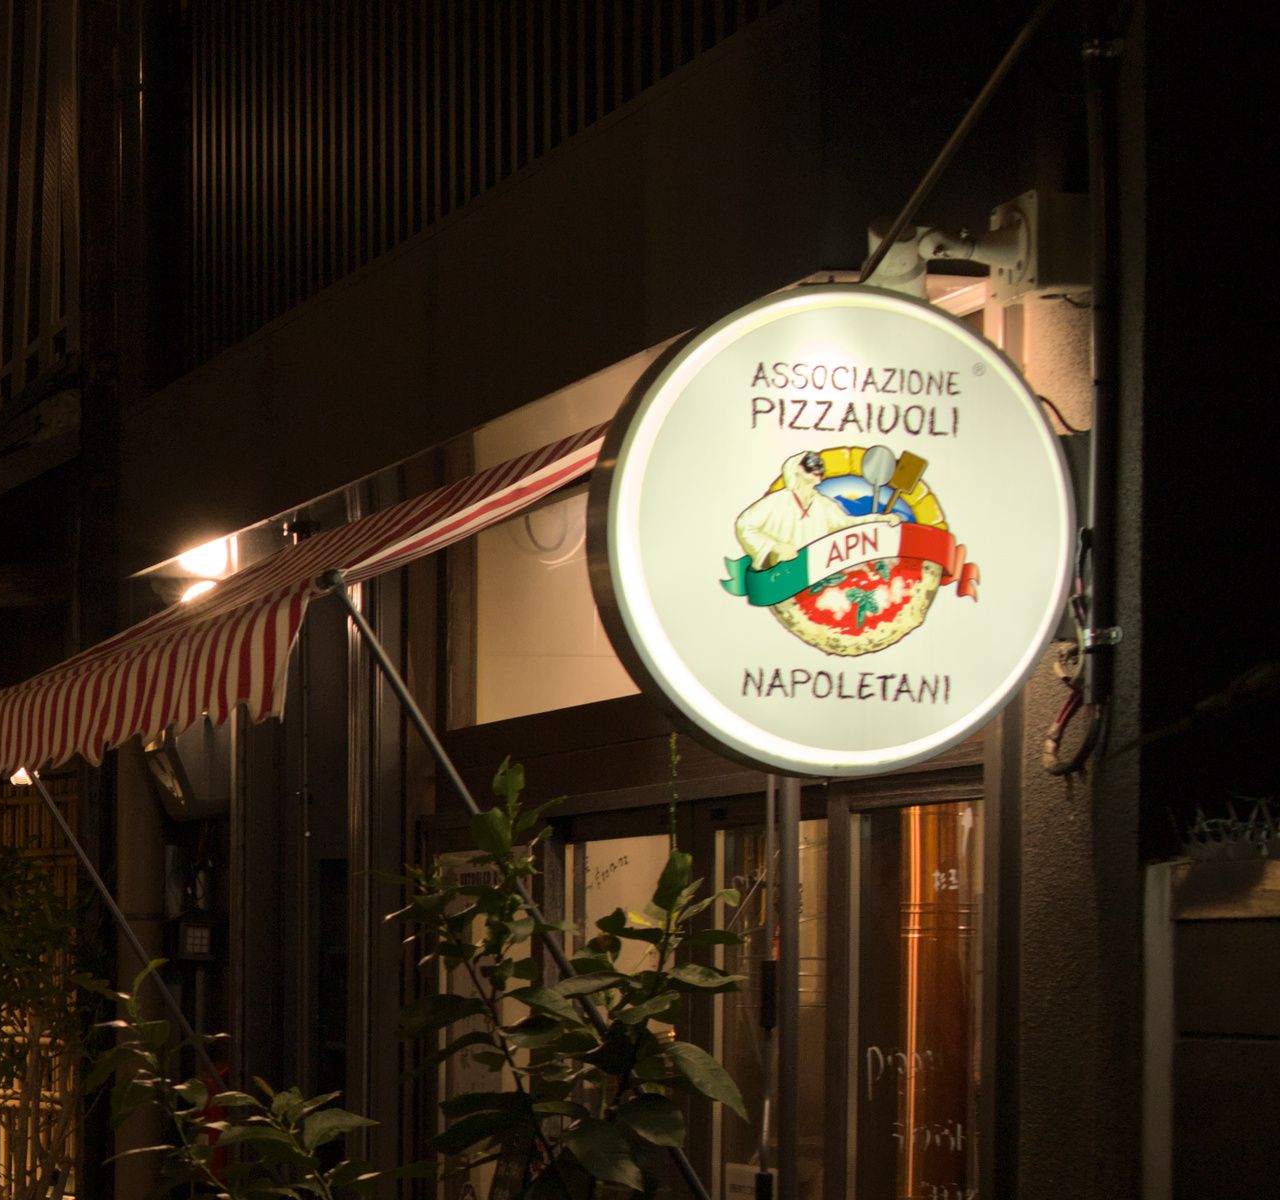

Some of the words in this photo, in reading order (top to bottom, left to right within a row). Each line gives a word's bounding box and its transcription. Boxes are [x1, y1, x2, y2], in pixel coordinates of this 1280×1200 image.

[750, 360, 962, 397] ASSOCIAZIONE
[750, 398, 960, 438] PIZZAIUOLI
[825, 527, 880, 569] APN
[741, 667, 952, 705] NAPOLETANI
